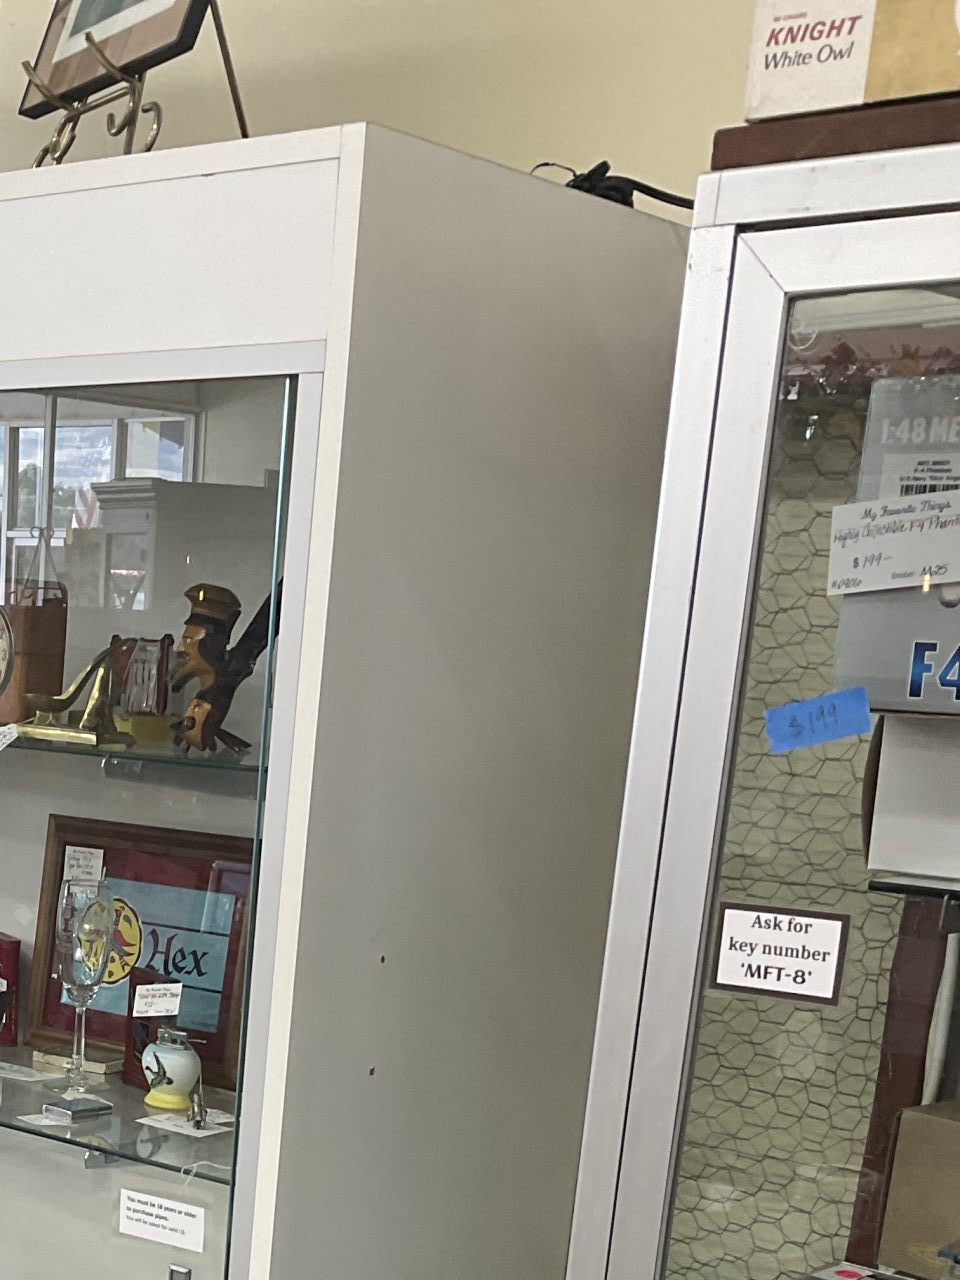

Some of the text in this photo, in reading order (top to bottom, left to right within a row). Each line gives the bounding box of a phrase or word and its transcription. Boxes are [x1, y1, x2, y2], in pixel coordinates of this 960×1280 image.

[766, 14, 863, 48] KNIGHT
[764, 40, 855, 71] White Owl
[907, 640, 960, 701] F4
[788, 703, 839, 739] $199
[751, 914, 813, 934] Ask for
[145, 927, 210, 978] Hex
[728, 936, 831, 962] key number
